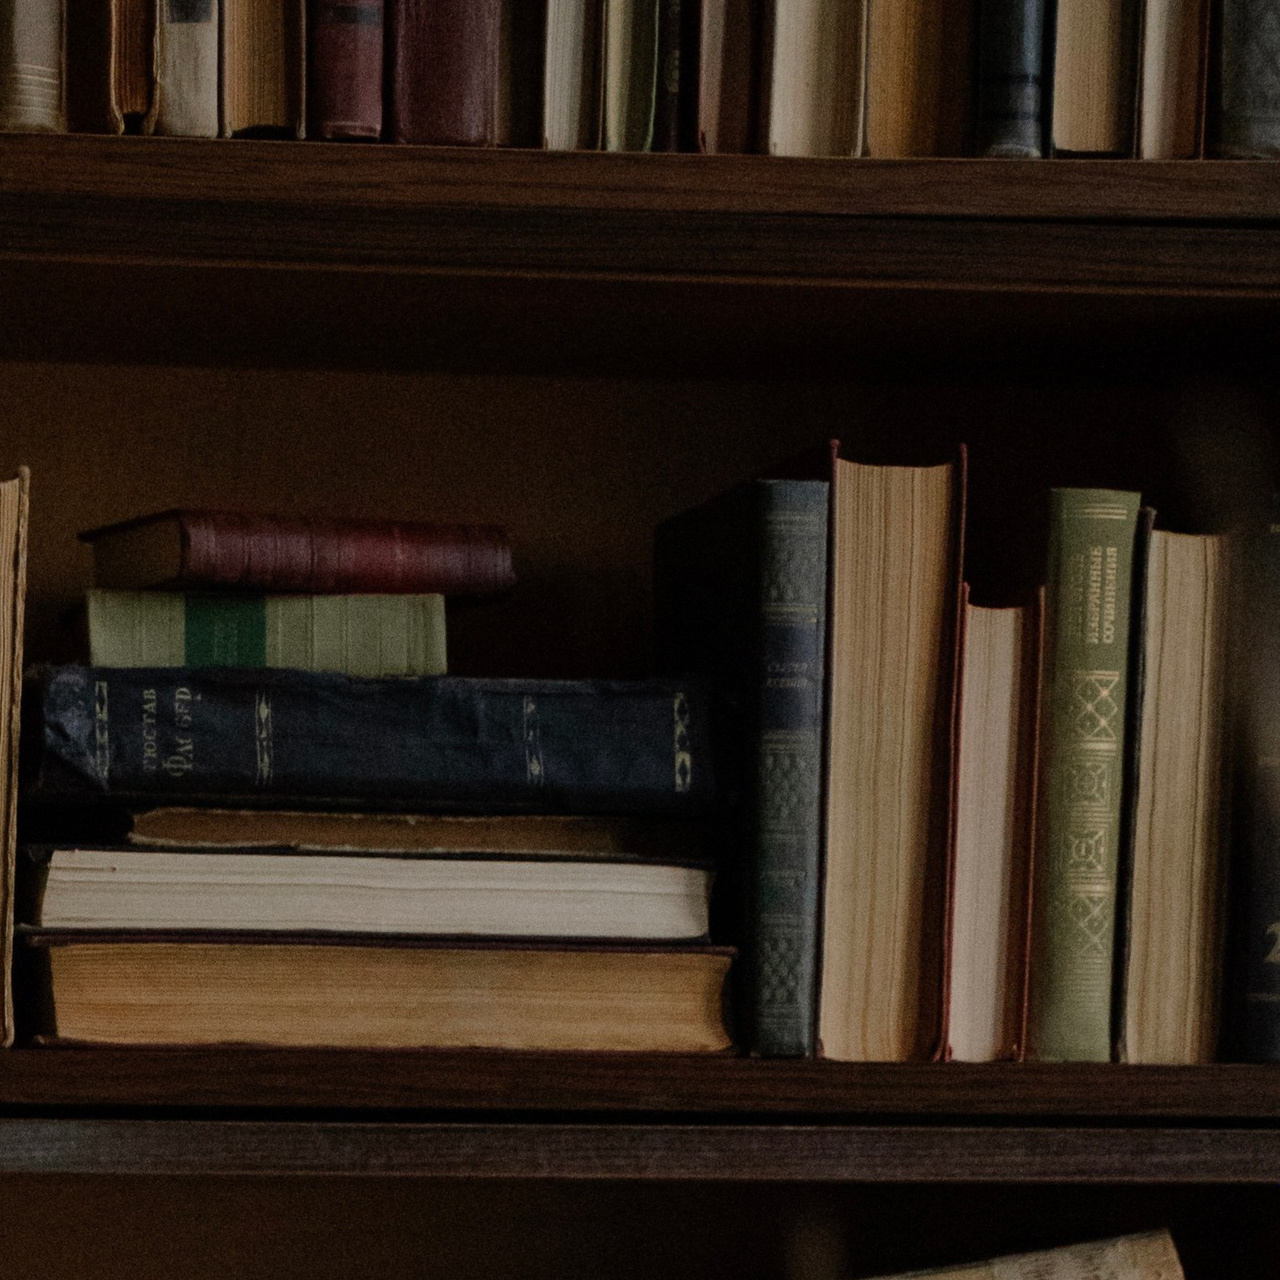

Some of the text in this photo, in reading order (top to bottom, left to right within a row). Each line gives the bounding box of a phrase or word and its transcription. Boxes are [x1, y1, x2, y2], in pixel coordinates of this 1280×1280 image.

[1086, 545, 1103, 645] ИЗБРАННЫЕ
[1103, 546, 1118, 645] СОЧИНЕНИЯ
[141, 687, 157, 773] ГЮСТАВ
